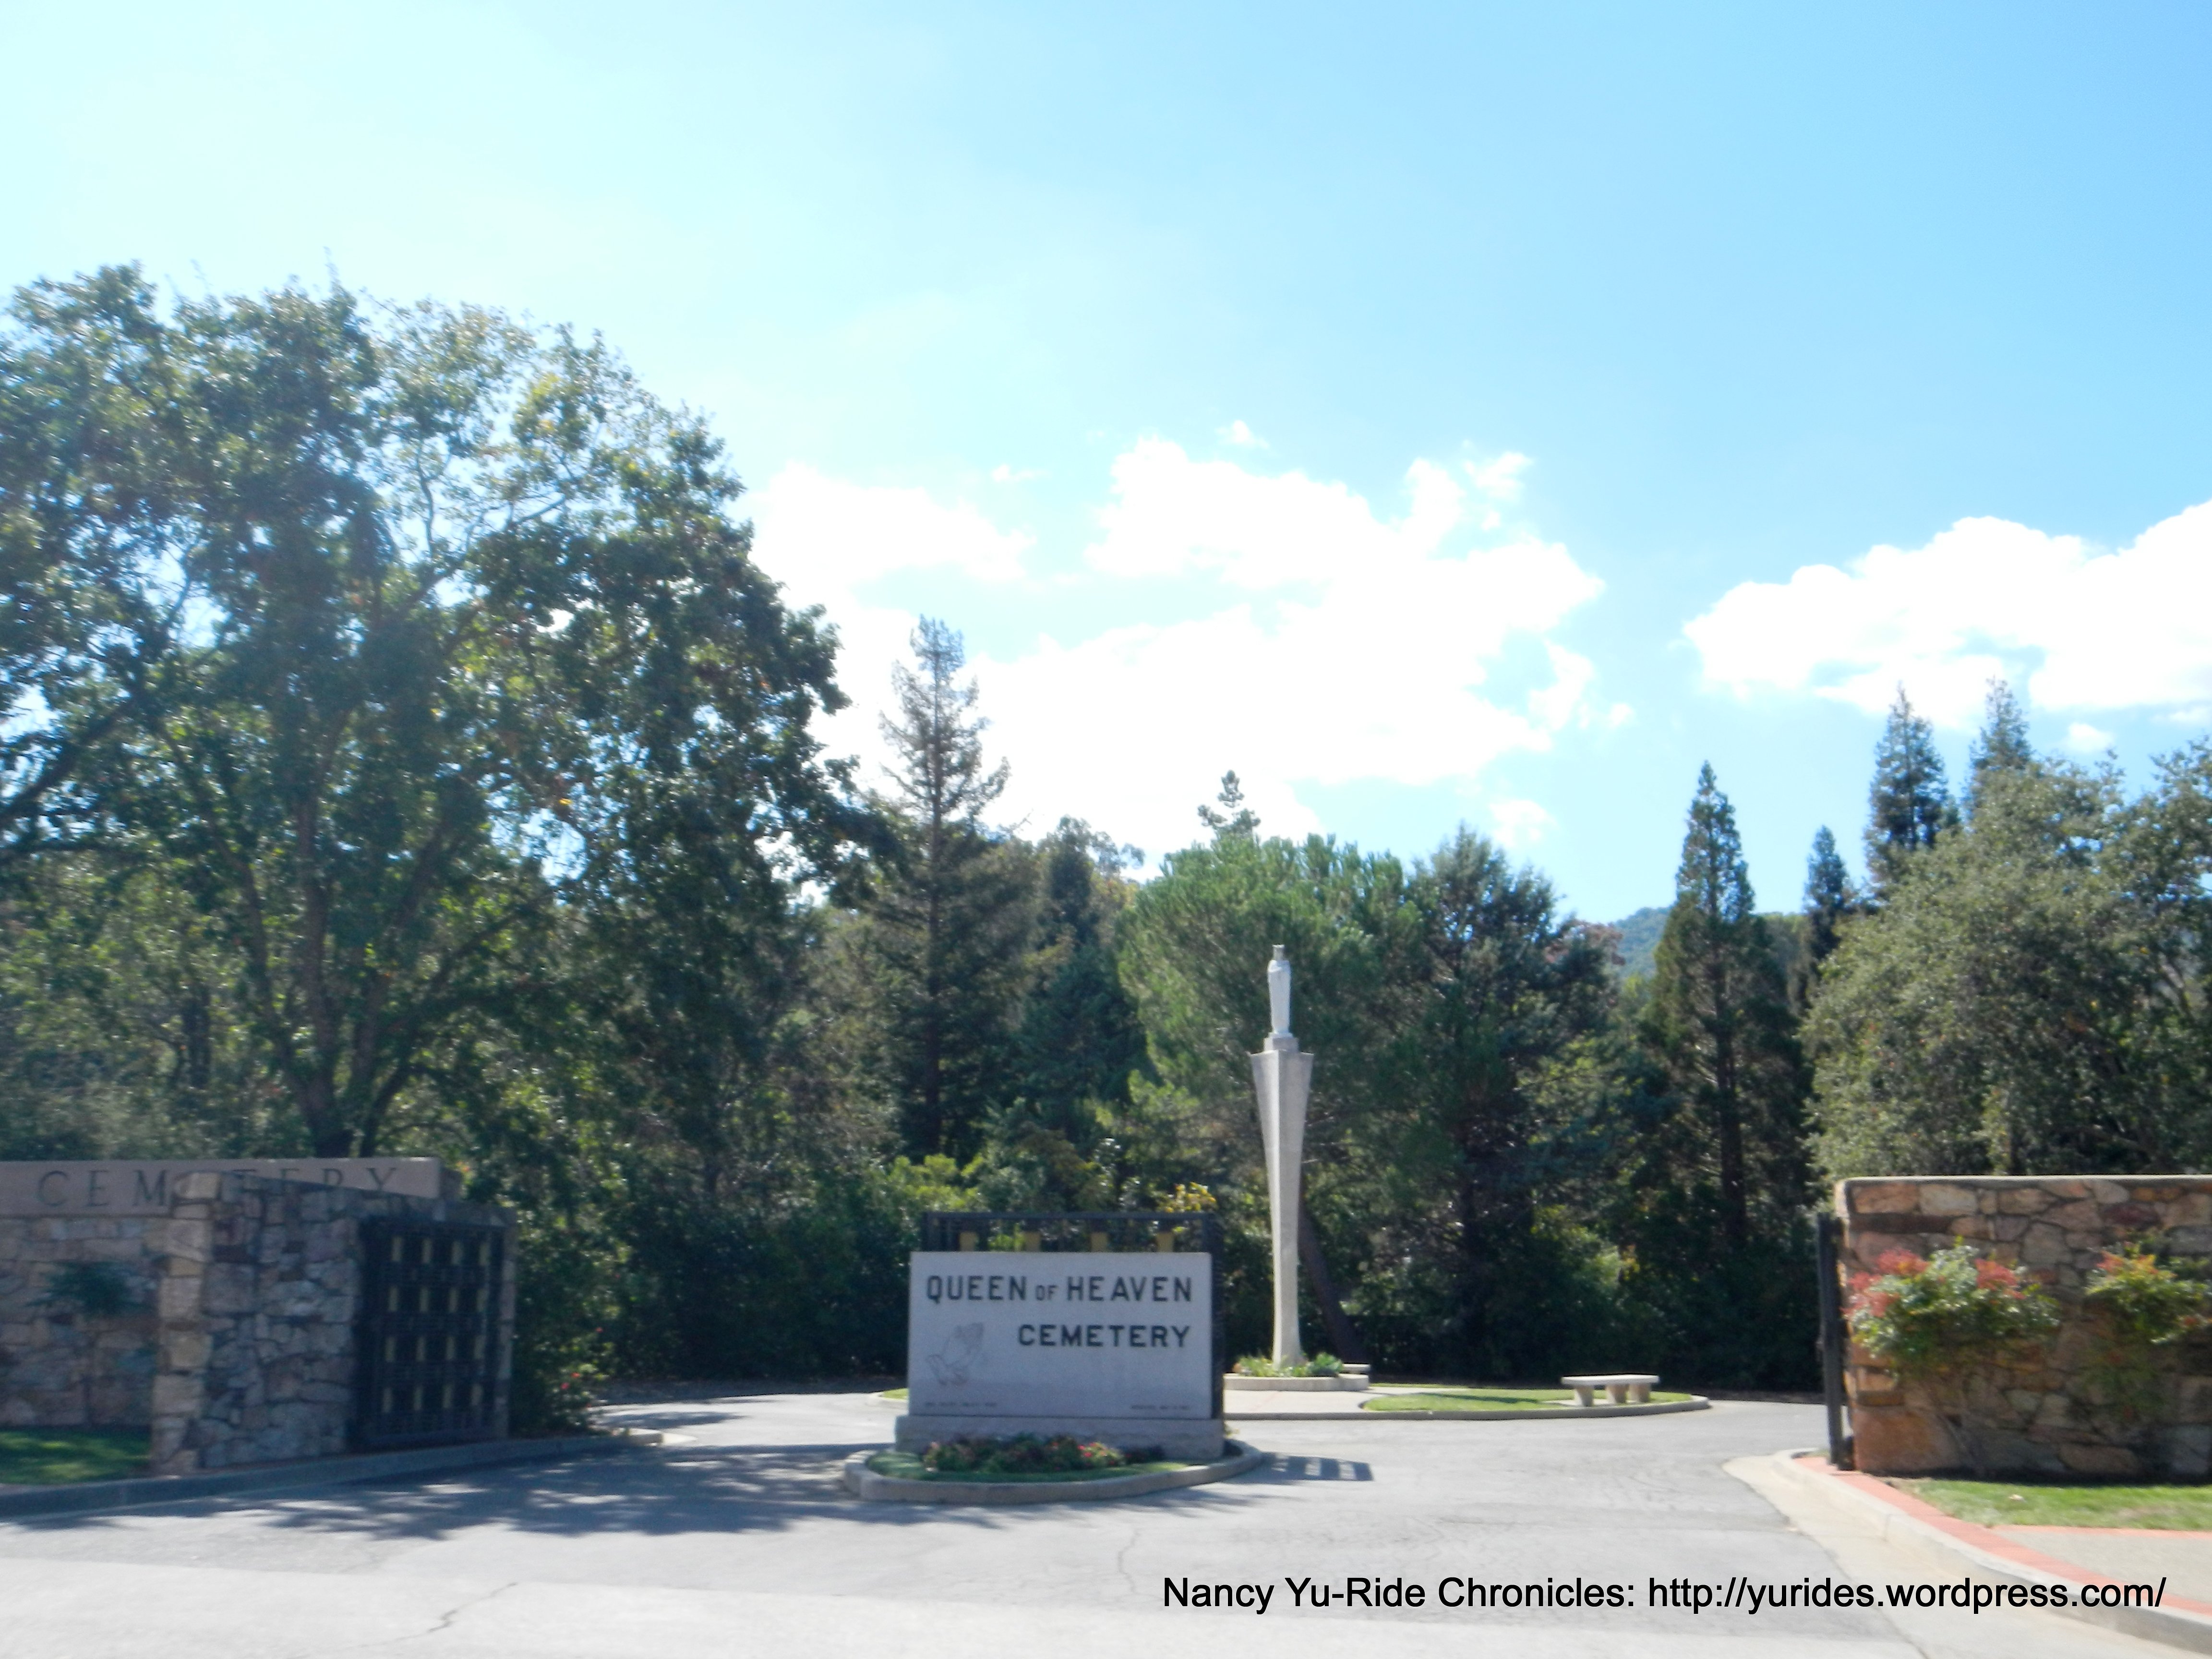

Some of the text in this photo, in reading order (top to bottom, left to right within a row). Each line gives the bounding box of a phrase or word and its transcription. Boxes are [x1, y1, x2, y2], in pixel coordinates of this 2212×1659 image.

[38, 1167, 397, 1207] CEMRY
[927, 1275, 1192, 1304] QUEEN OF HEAVEN
[1018, 1323, 1191, 1347] CEMETERY
